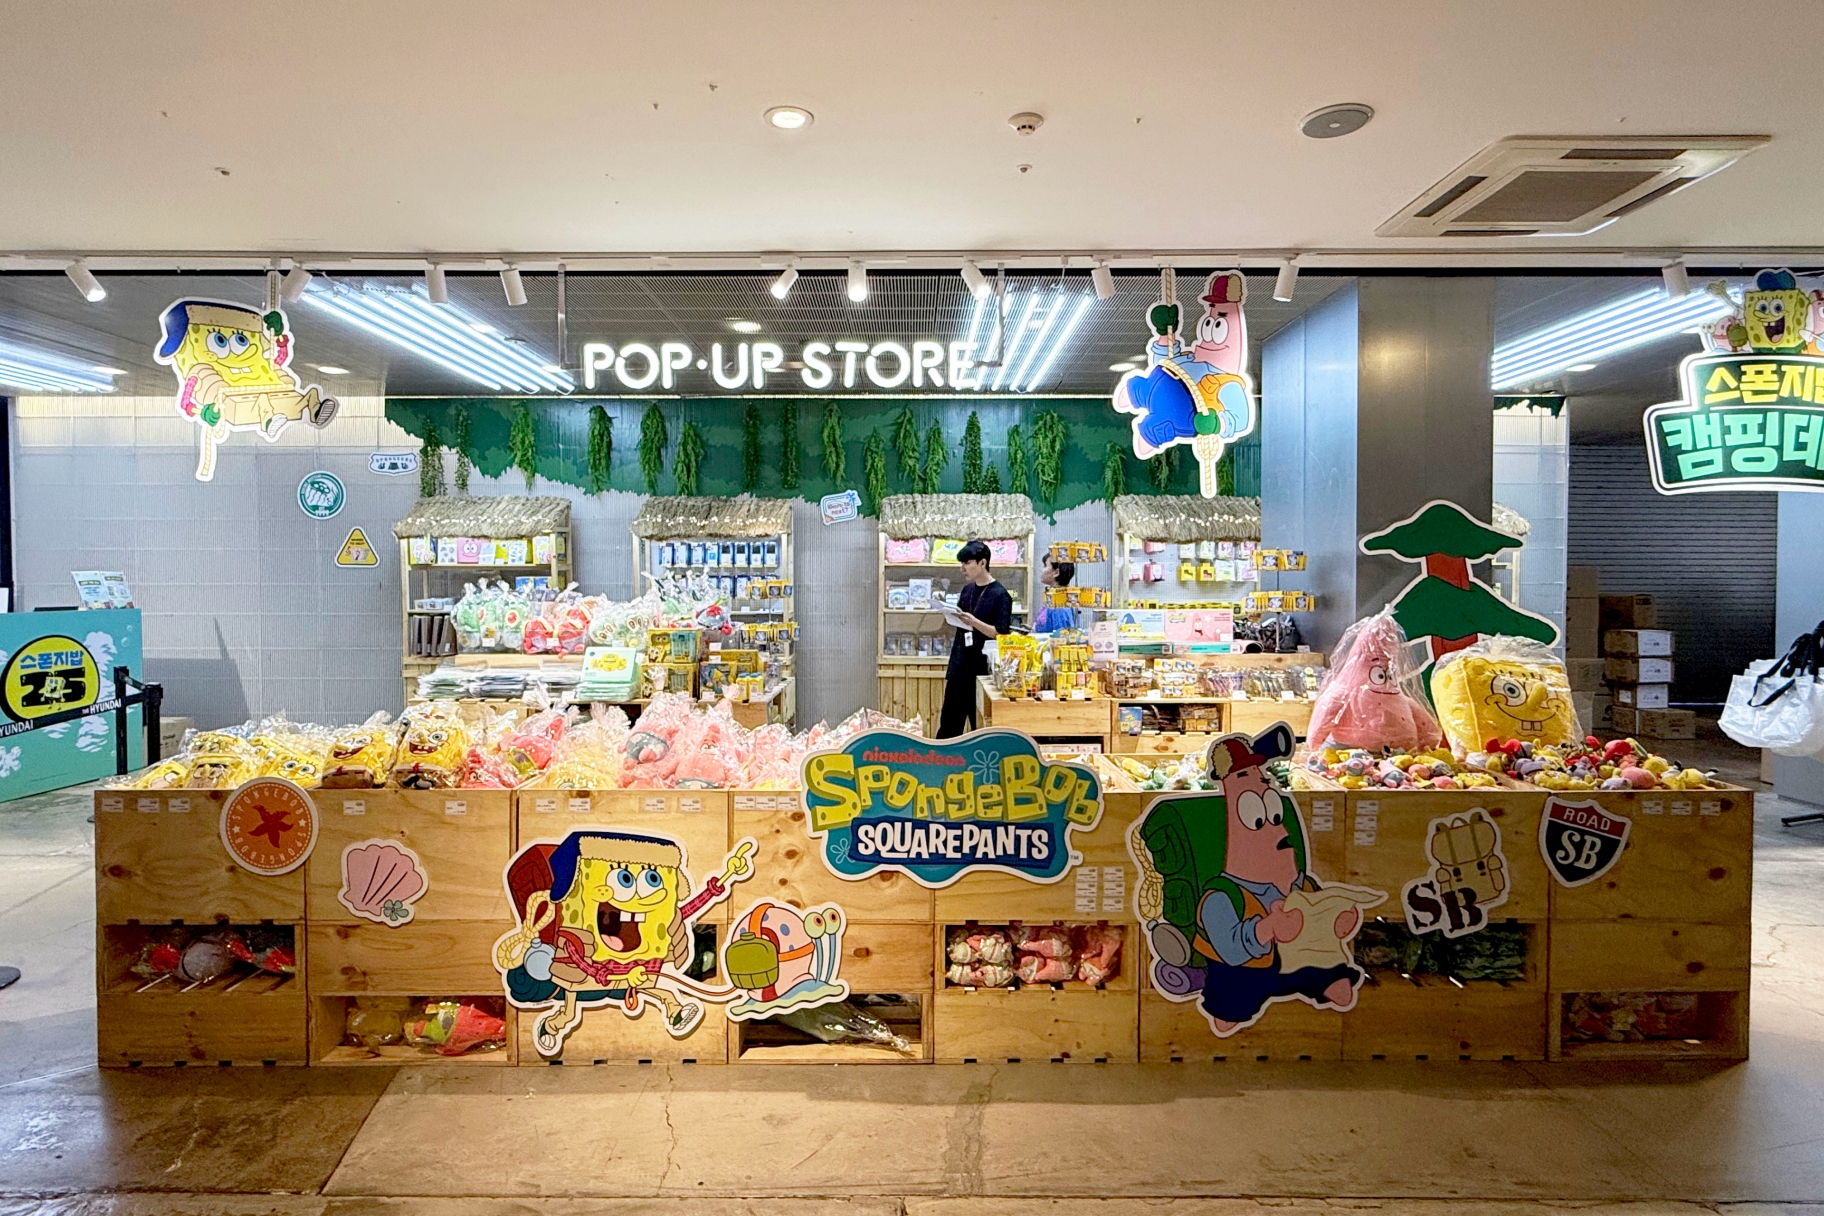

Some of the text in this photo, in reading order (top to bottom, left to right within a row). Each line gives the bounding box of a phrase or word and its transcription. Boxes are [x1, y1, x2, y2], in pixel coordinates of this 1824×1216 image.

[801, 341, 979, 389] STORE
[20, 651, 84, 670] 스폰지밥
[20, 667, 86, 707] 25
[90, 698, 122, 715] HYUNDAI
[0, 720, 34, 737] YUNDAI
[862, 746, 966, 767] nickelodeon
[232, 787, 304, 821] SPONGEBOB
[1563, 807, 1610, 831] ROAD
[234, 831, 307, 865] SPONGEBOB
[858, 821, 1049, 859] SQUAREPANTS
[1555, 830, 1602, 870] SB
[1407, 880, 1483, 933] SB
